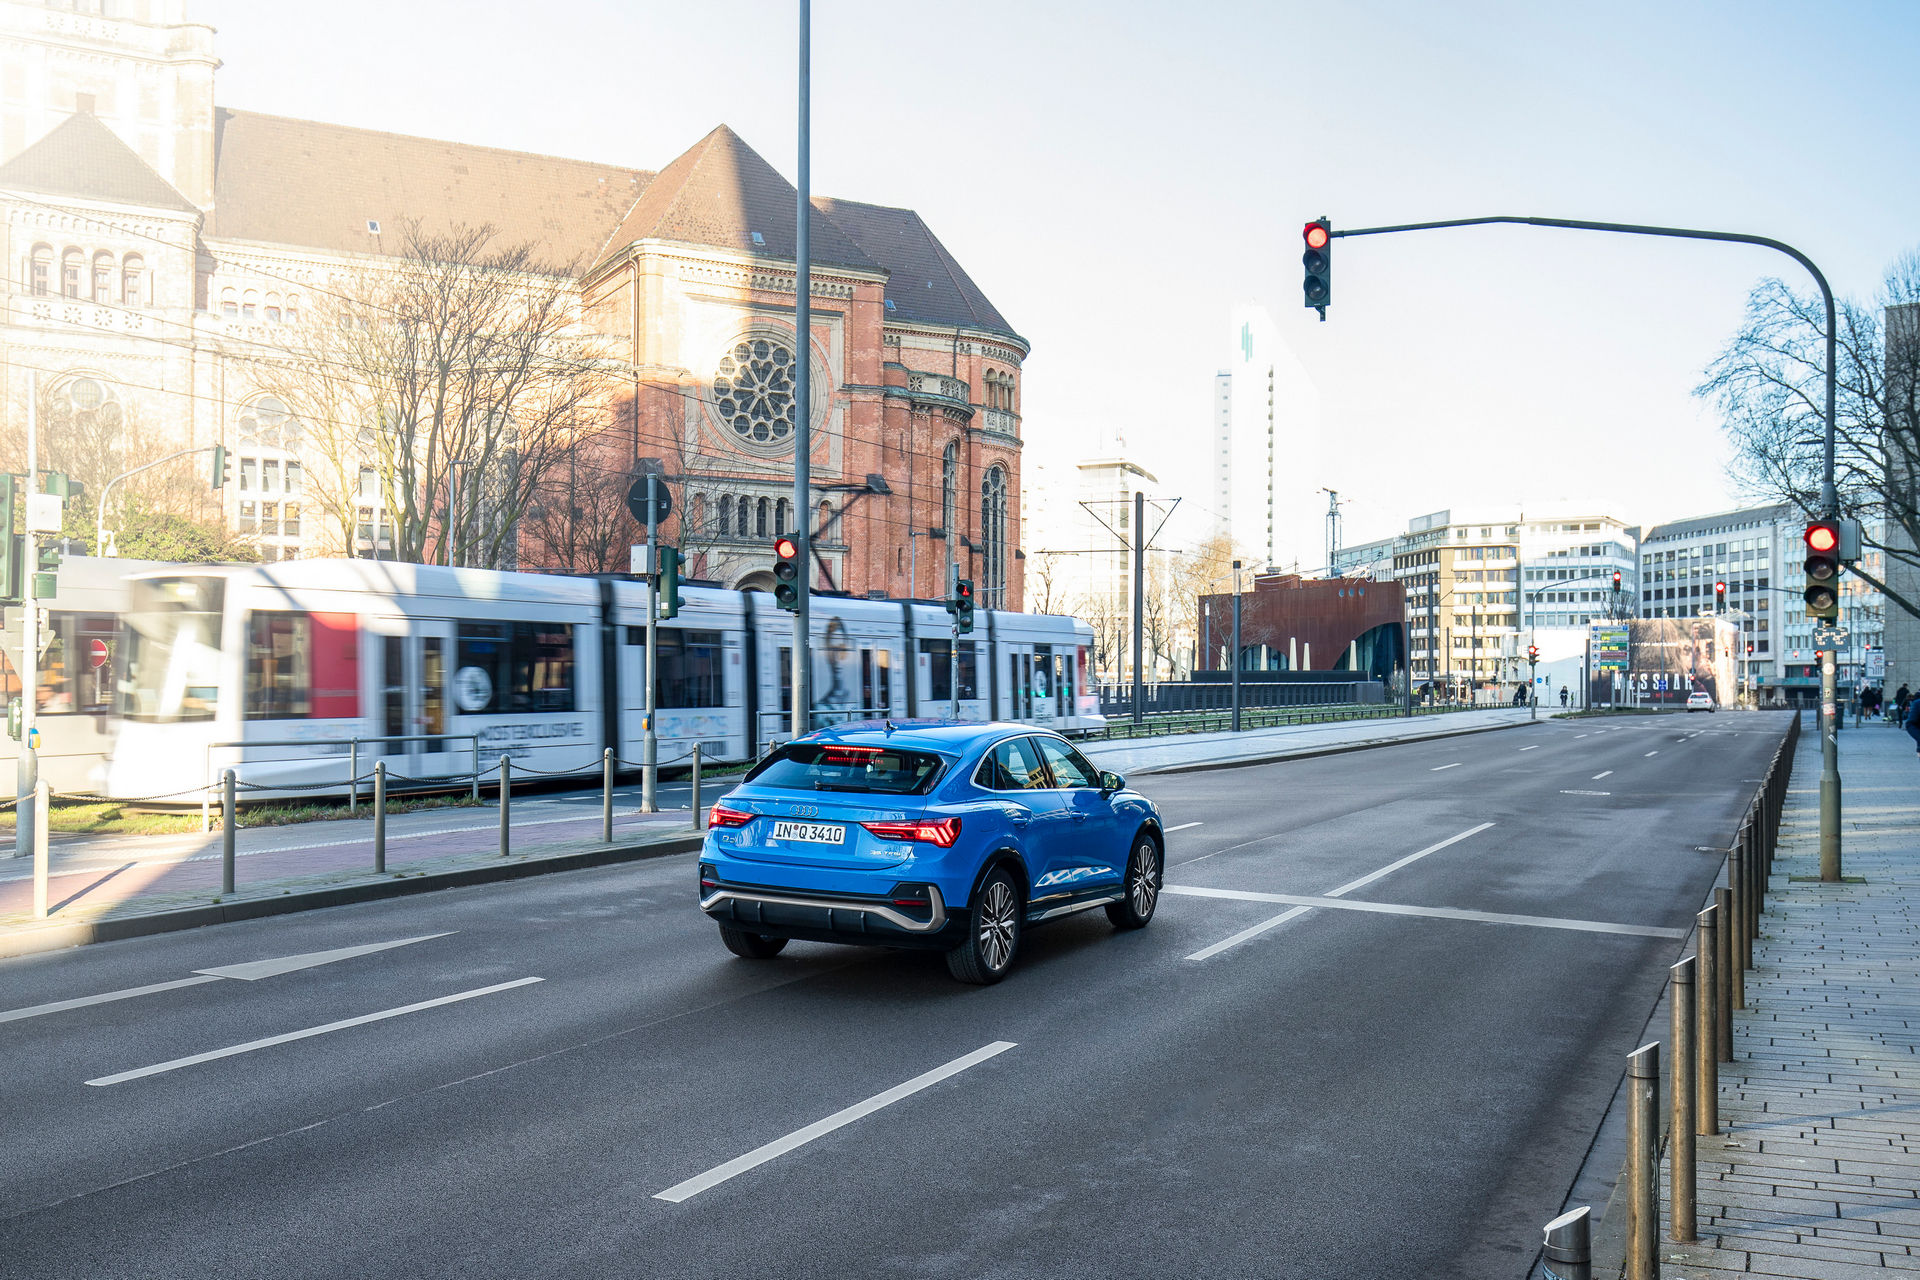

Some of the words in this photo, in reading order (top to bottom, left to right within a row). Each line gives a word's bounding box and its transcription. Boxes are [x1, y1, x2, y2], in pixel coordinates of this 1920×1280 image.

[775, 823, 793, 838] IN
[798, 825, 808, 839] Q
[809, 826, 842, 842] 3410
